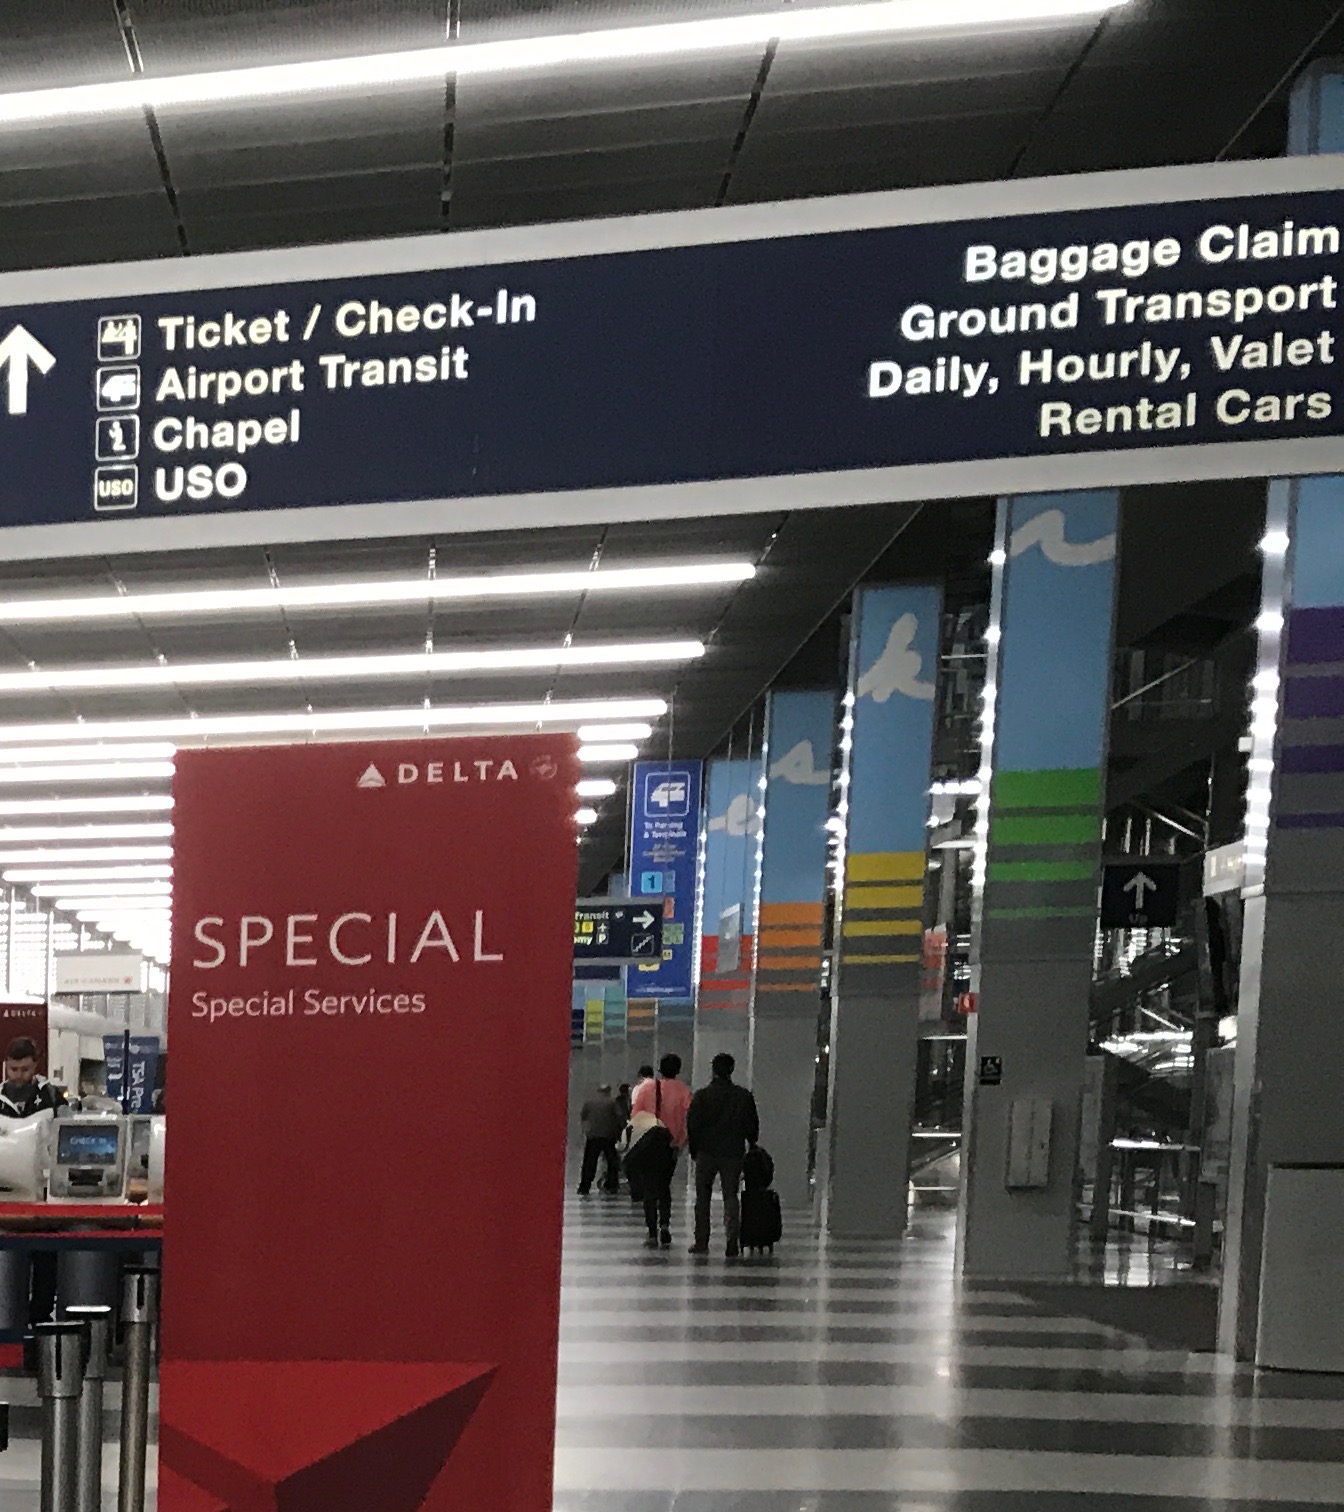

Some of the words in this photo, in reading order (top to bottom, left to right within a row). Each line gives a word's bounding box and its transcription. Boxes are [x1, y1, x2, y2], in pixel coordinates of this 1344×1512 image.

[965, 236, 1181, 285] Baggage
[1199, 221, 1339, 263] Claim
[157, 309, 290, 351] Ticket
[302, 304, 322, 341] /
[334, 288, 537, 338] Check-In
[900, 292, 1079, 341] Ground
[1096, 274, 1338, 326] Transport
[155, 358, 306, 405] Airport
[318, 345, 470, 390] Transit
[868, 355, 1000, 399] Daily,
[1018, 341, 1191, 386] Hourly,
[1210, 330, 1335, 373] Valet
[152, 409, 301, 452] Chapel
[1038, 393, 1197, 438] Rental
[1215, 388, 1332, 425] Cars
[99, 479, 134, 497] USO
[153, 462, 248, 501] USO
[398, 759, 519, 784] DELTA
[192, 909, 504, 969] SPECIAL
[191, 989, 295, 1023] Special
[303, 988, 426, 1016] Services
